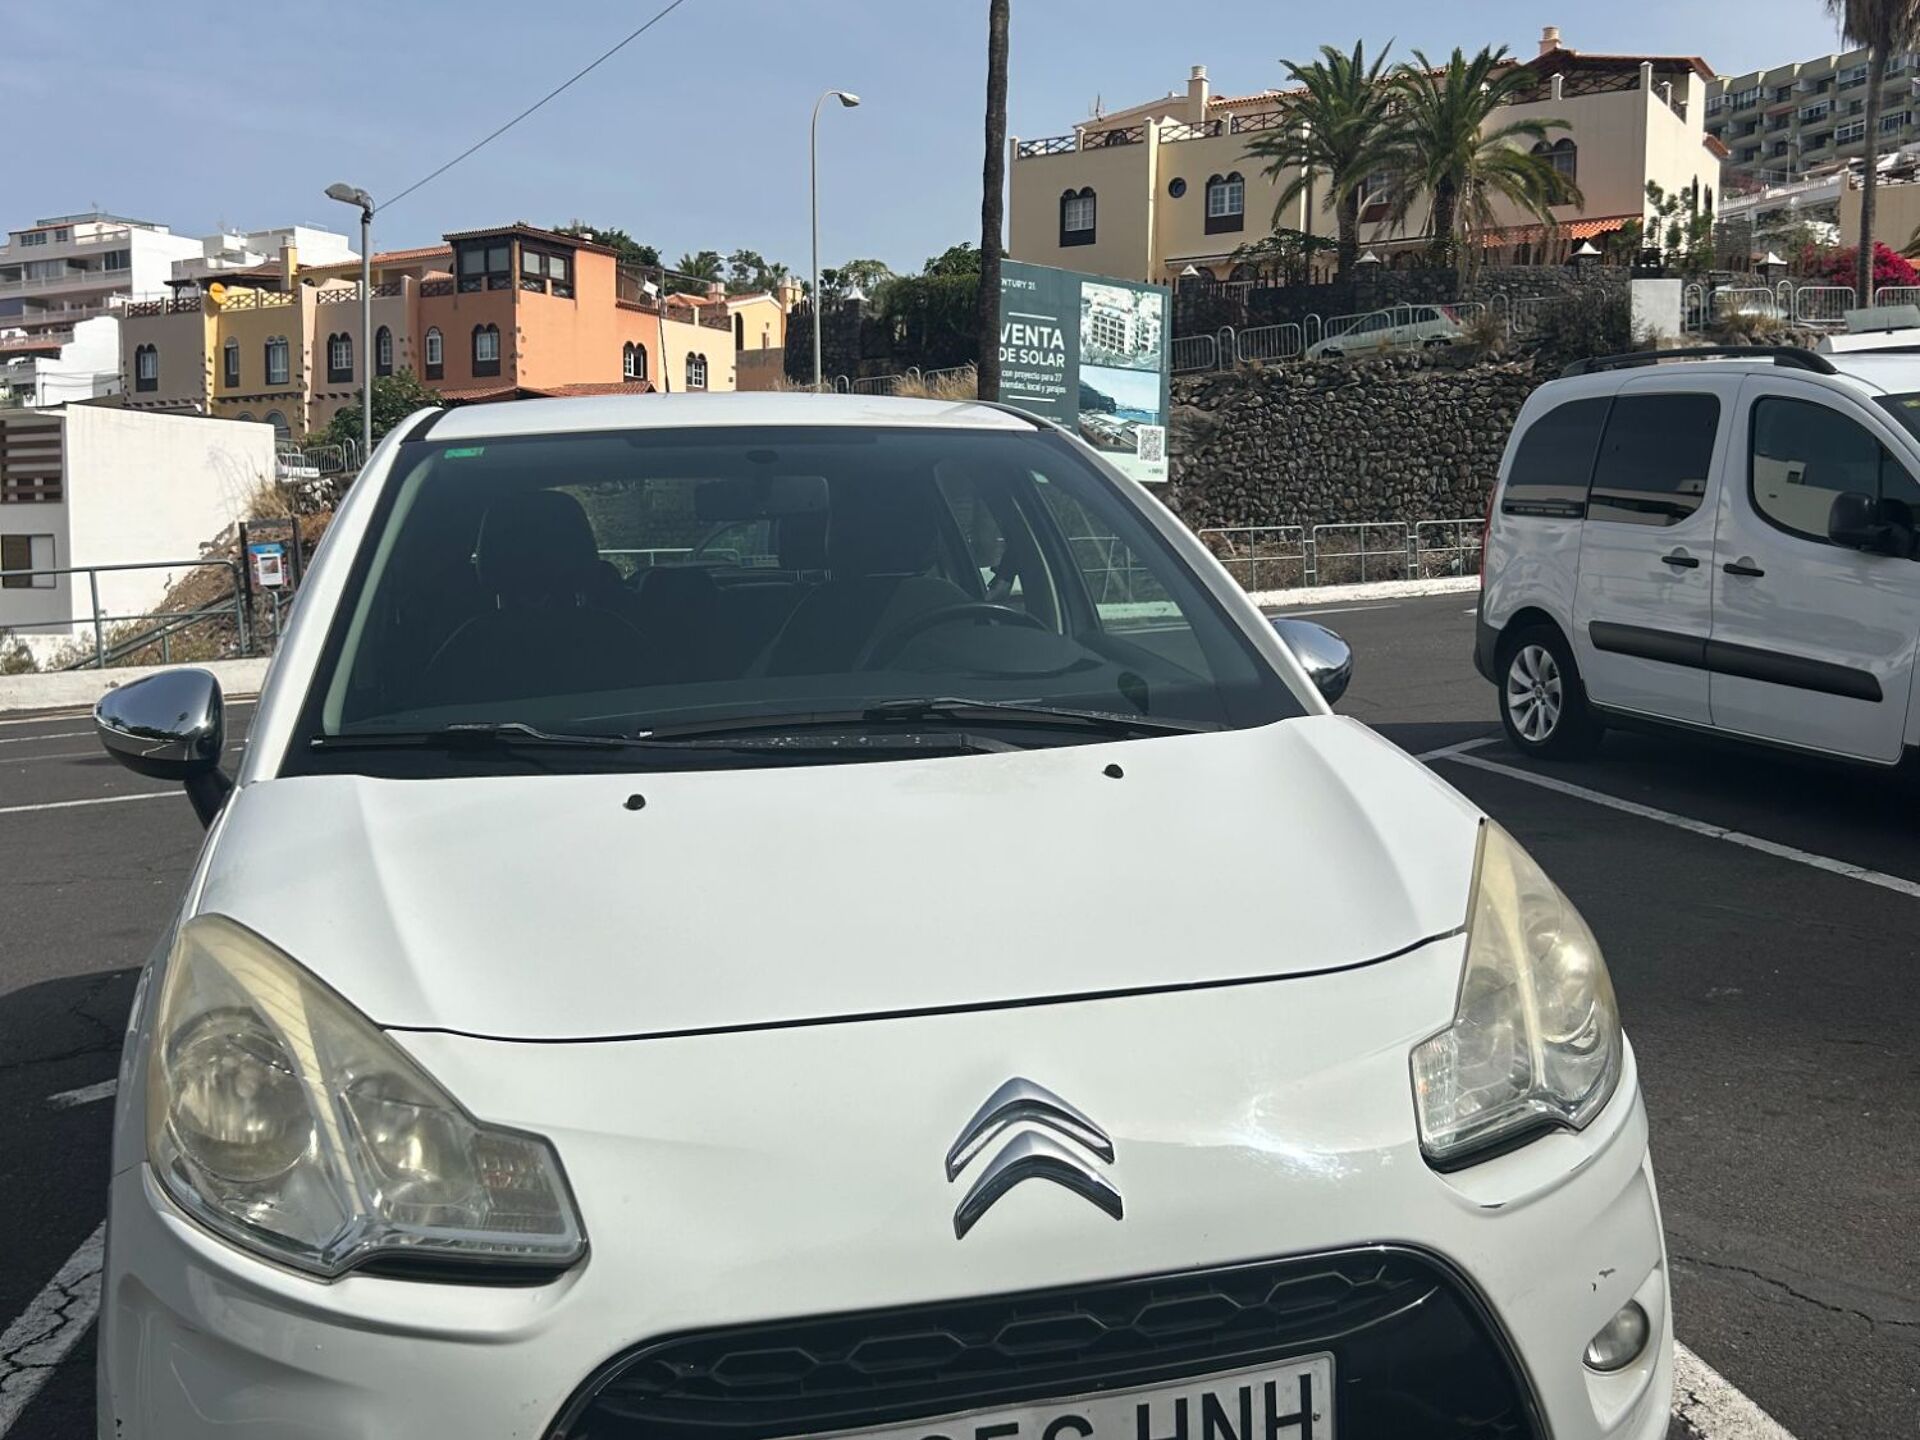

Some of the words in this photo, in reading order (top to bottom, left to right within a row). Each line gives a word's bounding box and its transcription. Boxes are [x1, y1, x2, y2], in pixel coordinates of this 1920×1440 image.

[1001, 278, 1027, 289] NTURY
[1000, 322, 1065, 350] VENTA
[999, 346, 1017, 362] DE
[1019, 349, 1065, 368] SOLAR
